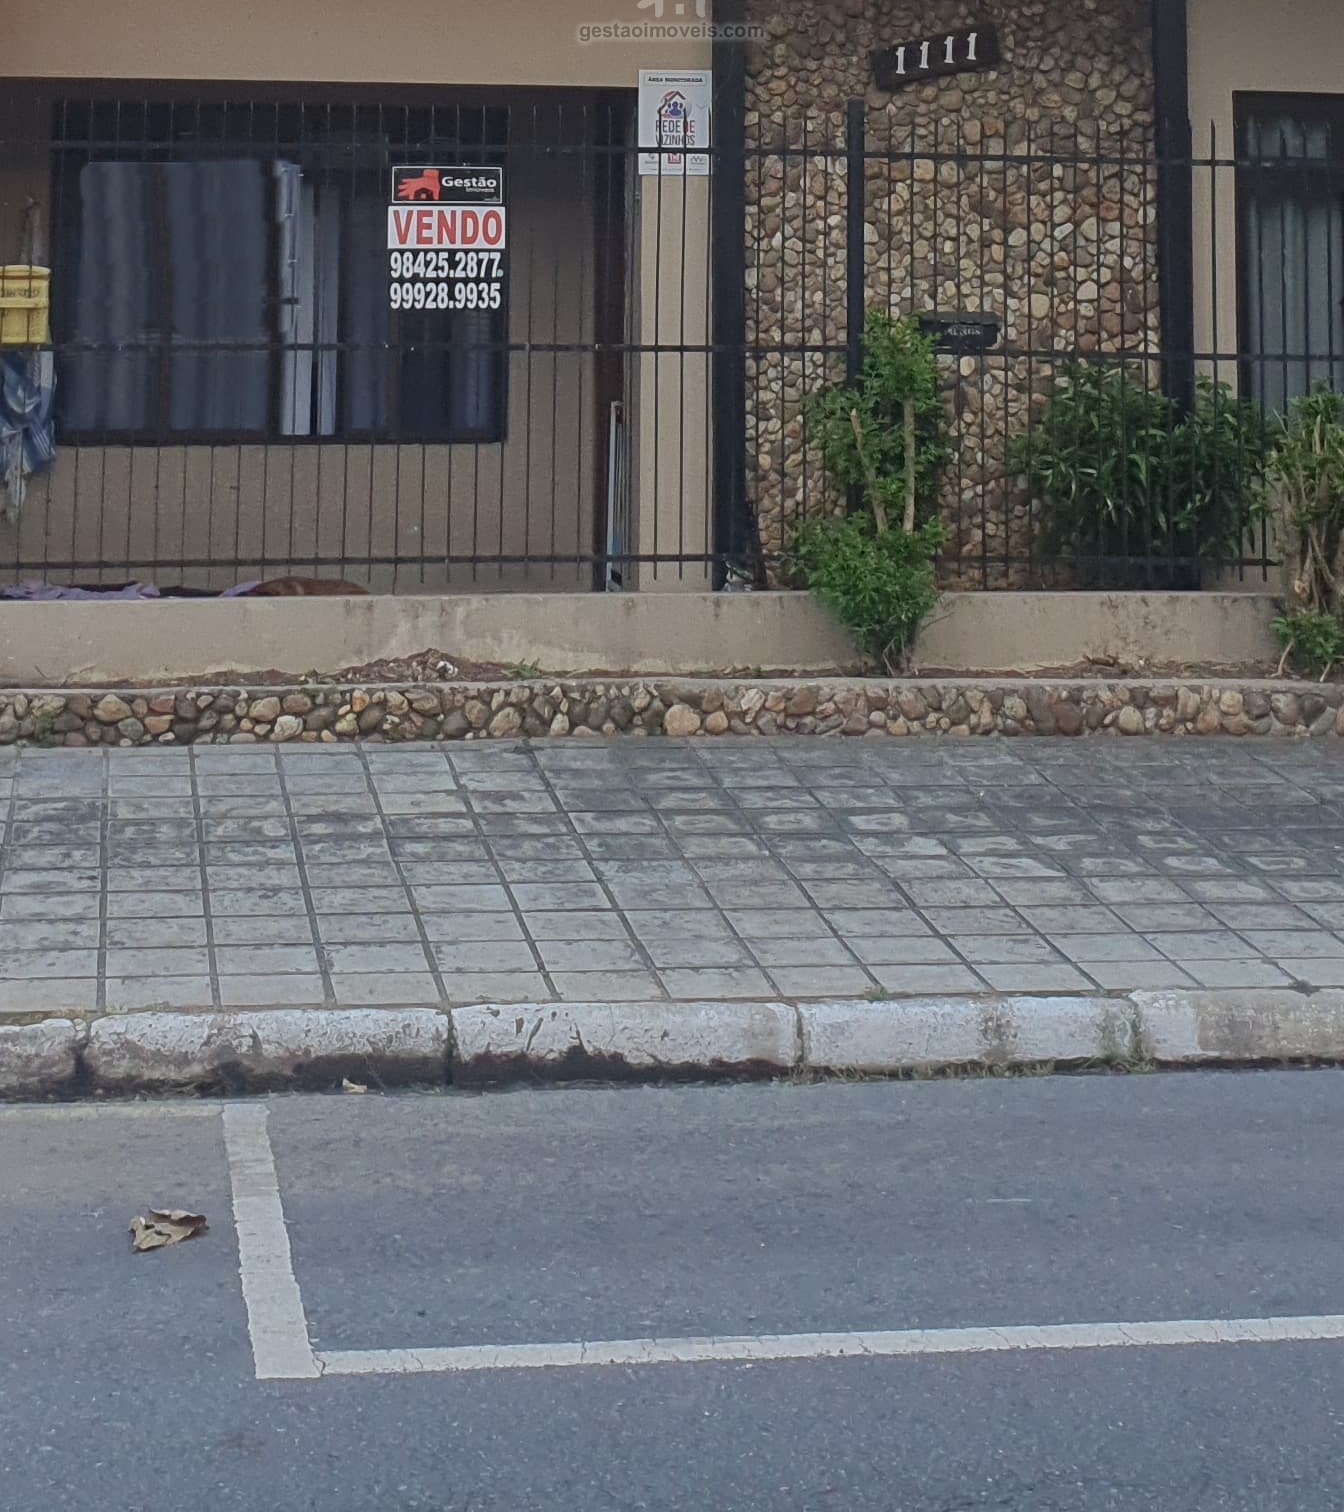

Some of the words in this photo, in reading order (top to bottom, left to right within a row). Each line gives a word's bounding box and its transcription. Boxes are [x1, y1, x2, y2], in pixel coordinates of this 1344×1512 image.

[896, 32, 977, 74] 1111
[441, 176, 497, 187] Gestão
[392, 209, 503, 245] VENDO
[390, 251, 501, 278] 98425.2877
[390, 282, 501, 309] 99928.9935
